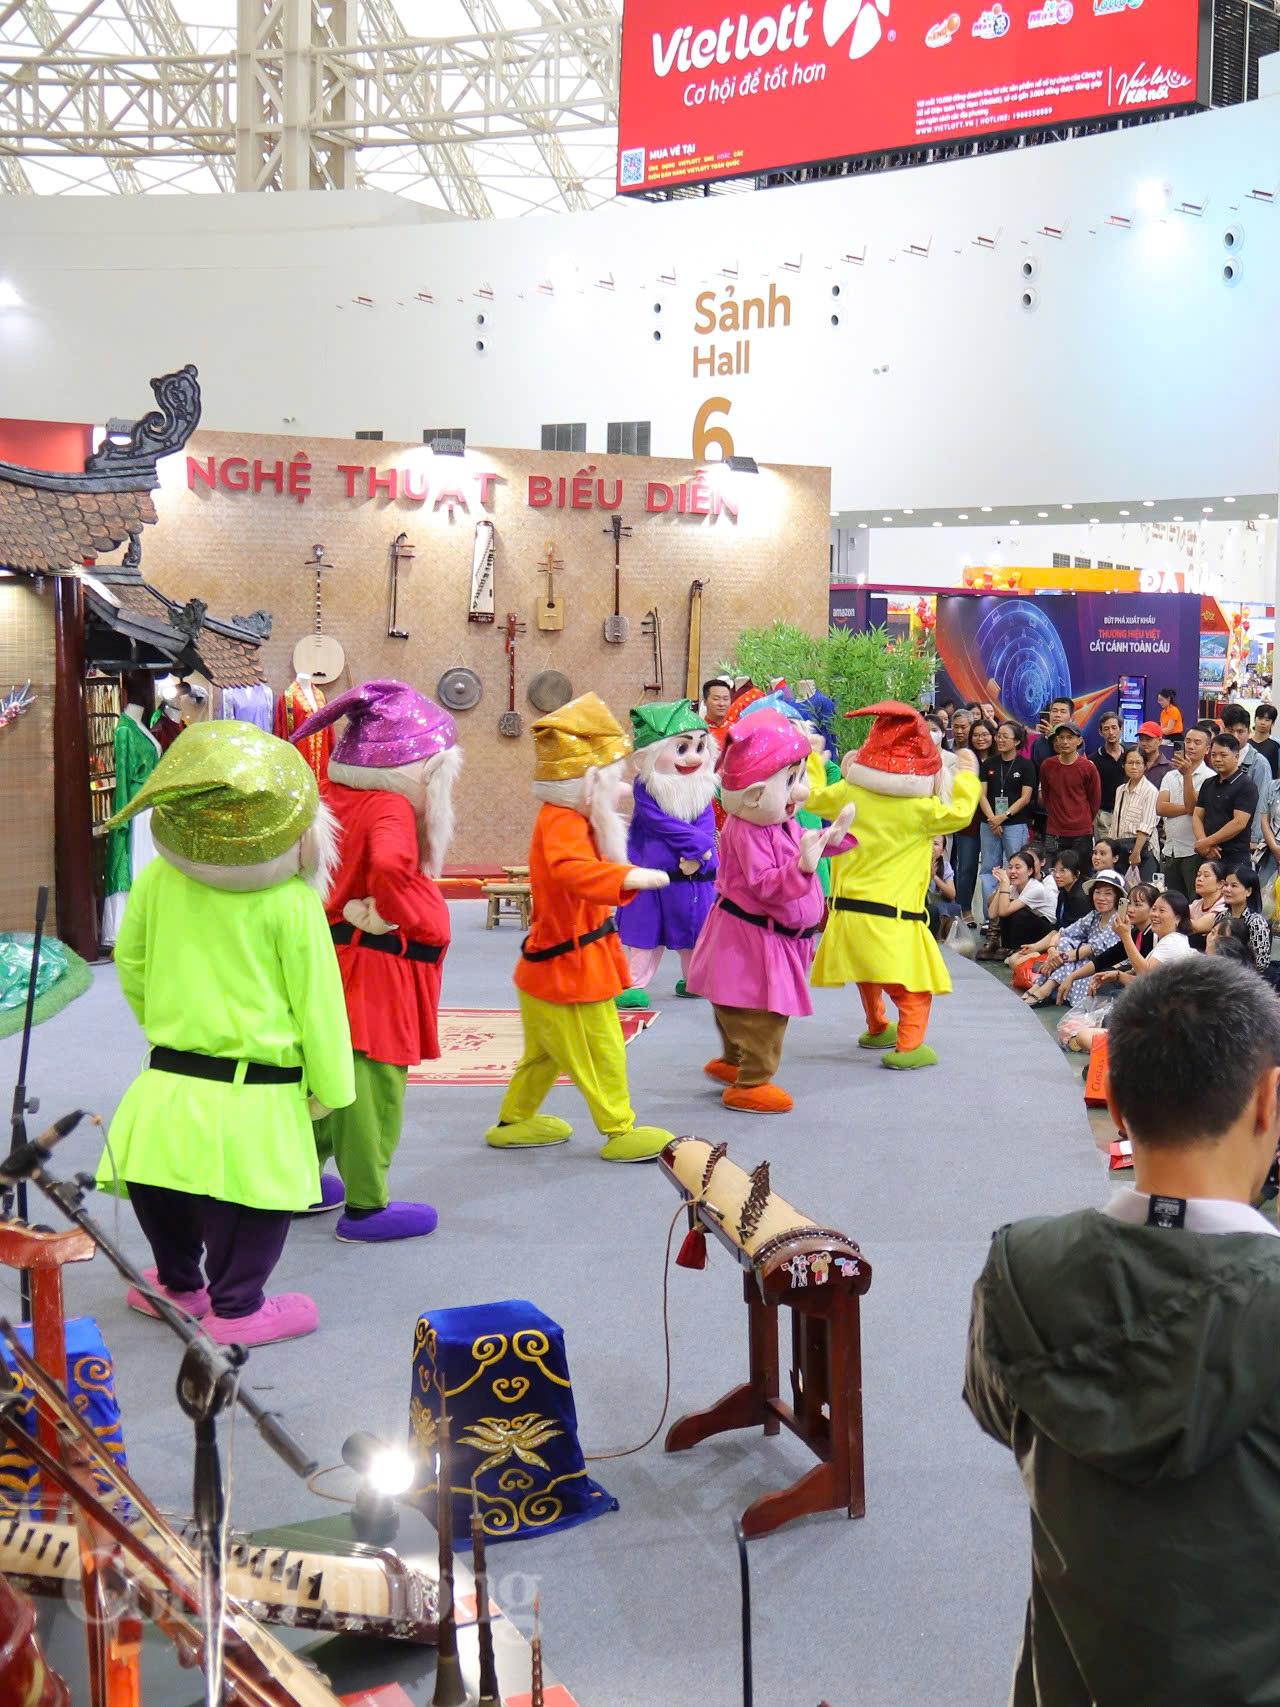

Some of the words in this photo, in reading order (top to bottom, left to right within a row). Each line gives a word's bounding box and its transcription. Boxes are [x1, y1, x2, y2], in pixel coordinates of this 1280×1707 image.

[652, 1, 813, 77] Vietlott
[684, 84, 706, 107] Cơ
[709, 76, 736, 104] hội
[739, 68, 762, 96] để
[764, 64, 788, 92] tốt
[792, 62, 827, 85] hơn
[649, 148, 669, 160] MUA
[694, 283, 791, 335] Sảnh
[693, 340, 750, 378] Hall
[692, 396, 735, 461] 6
[186, 450, 312, 504] NGHỆ
[528, 464, 623, 510] BIỂU
[832, 608, 855, 617] amazon
[1105, 639, 1128, 652] CÁNH
[1129, 639, 1152, 653] TOÀN
